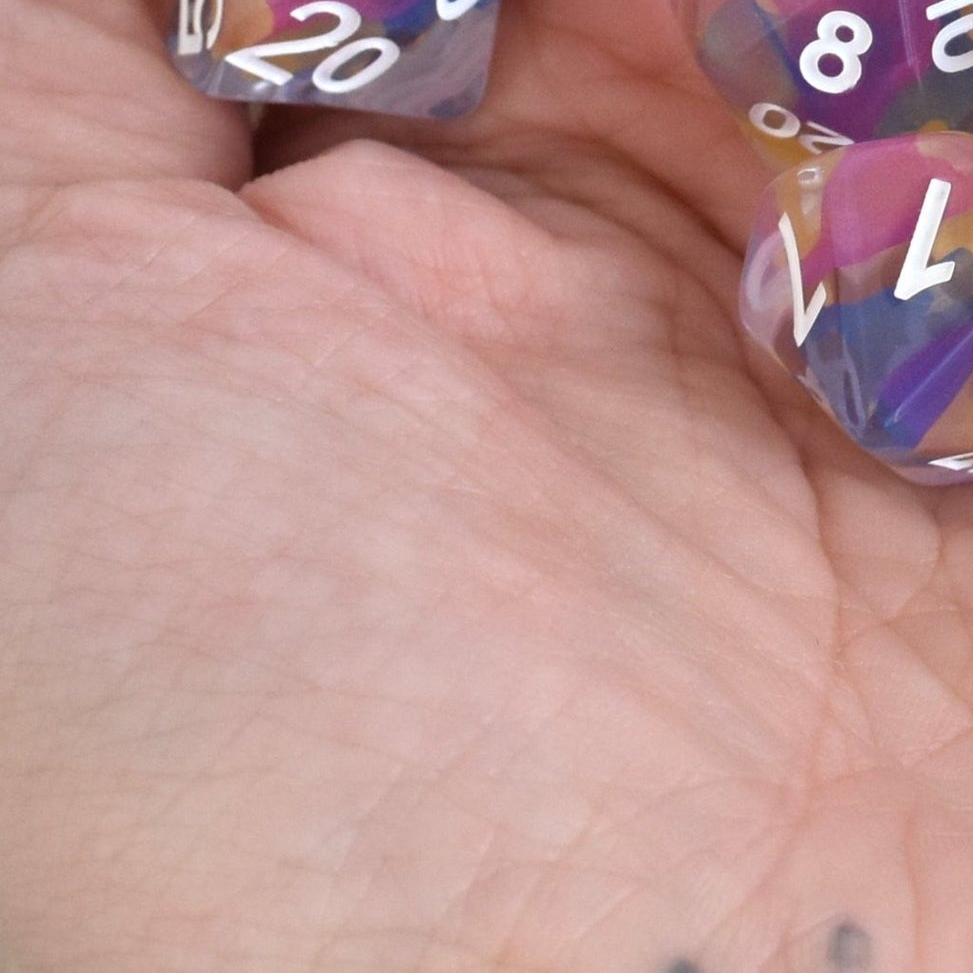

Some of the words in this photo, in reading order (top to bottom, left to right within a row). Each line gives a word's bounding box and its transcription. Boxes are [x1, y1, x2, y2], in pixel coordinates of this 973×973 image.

[224, 0, 401, 94] 20
[799, 10, 873, 95] 8
[748, 102, 856, 155] 20
[894, 178, 956, 301] 1
